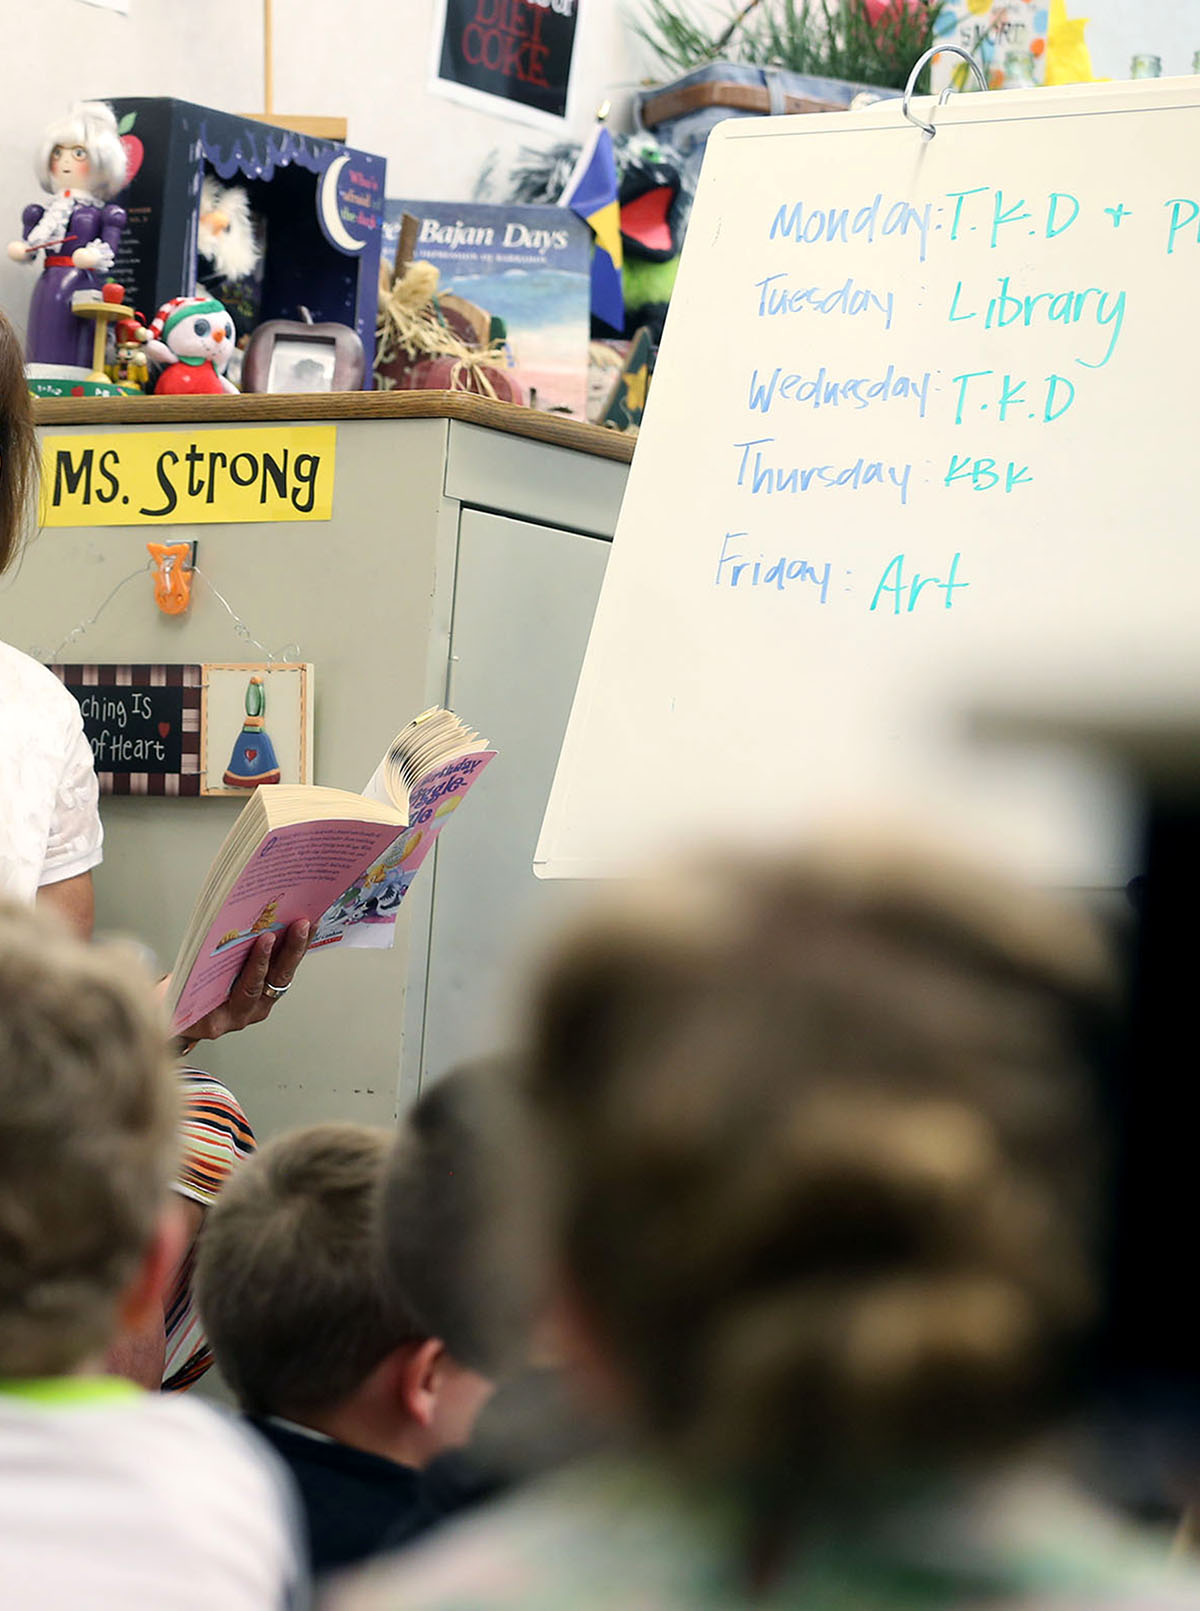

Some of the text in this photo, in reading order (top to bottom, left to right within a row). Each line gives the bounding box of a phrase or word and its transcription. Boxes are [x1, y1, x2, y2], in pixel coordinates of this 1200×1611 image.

[462, 23, 552, 89] COKE
[419, 218, 495, 250] Bajan
[502, 222, 569, 255] Days
[1164, 198, 1200, 254] P
[949, 277, 1126, 368] Library
[870, 553, 970, 614] Art
[81, 694, 127, 728] ching
[109, 735, 165, 761] Heart
